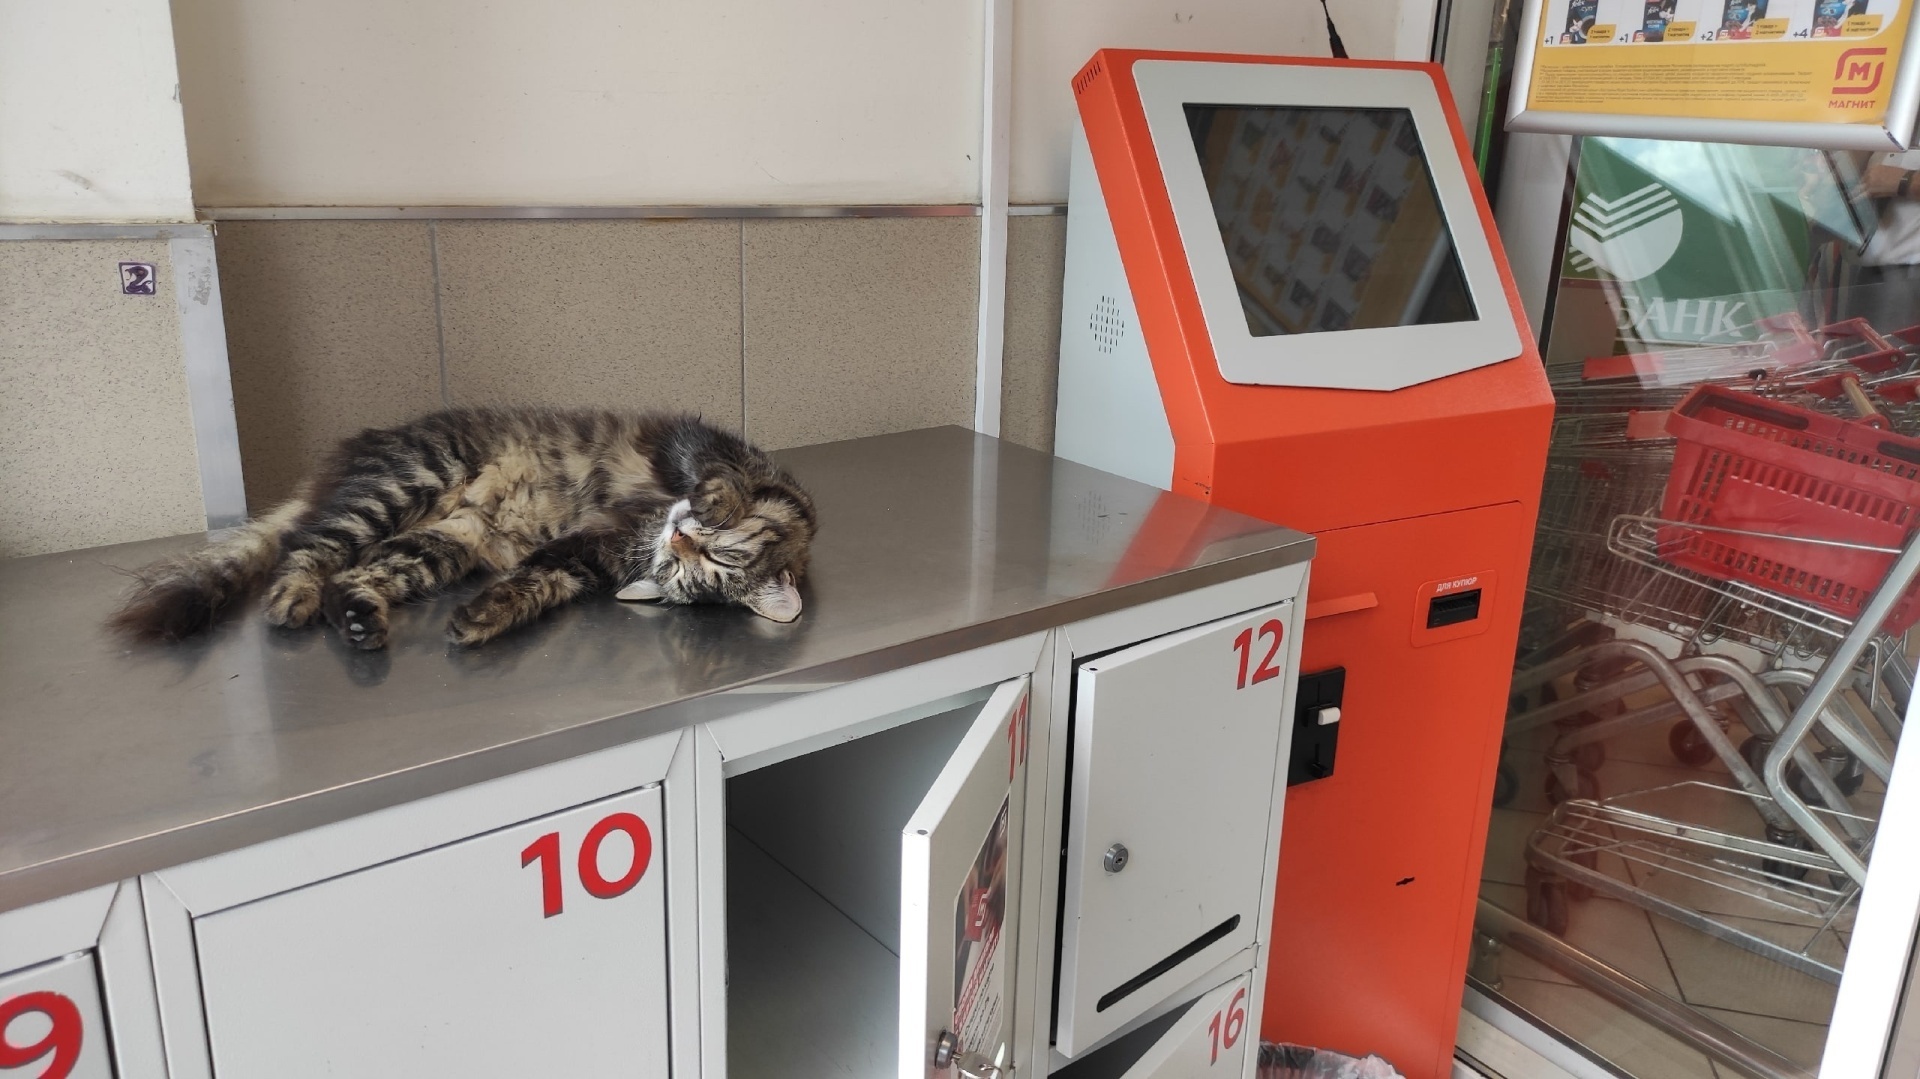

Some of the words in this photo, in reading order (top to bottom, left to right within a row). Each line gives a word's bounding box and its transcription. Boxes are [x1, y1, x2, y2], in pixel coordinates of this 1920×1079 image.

[1545, 36, 1554, 45] +1
[1619, 33, 1629, 43] +1
[1701, 31, 1714, 41] +2
[1793, 28, 1808, 39] +4
[1828, 100, 1876, 108] МАГНИТ
[1436, 582, 1452, 593] ДЛЯ
[1452, 577, 1478, 589] КУПЮР
[1233, 618, 1284, 690] 12
[1008, 693, 1028, 784] 11
[521, 812, 653, 919] 10
[0, 990, 84, 1079] 9
[1208, 987, 1245, 1067] 16
